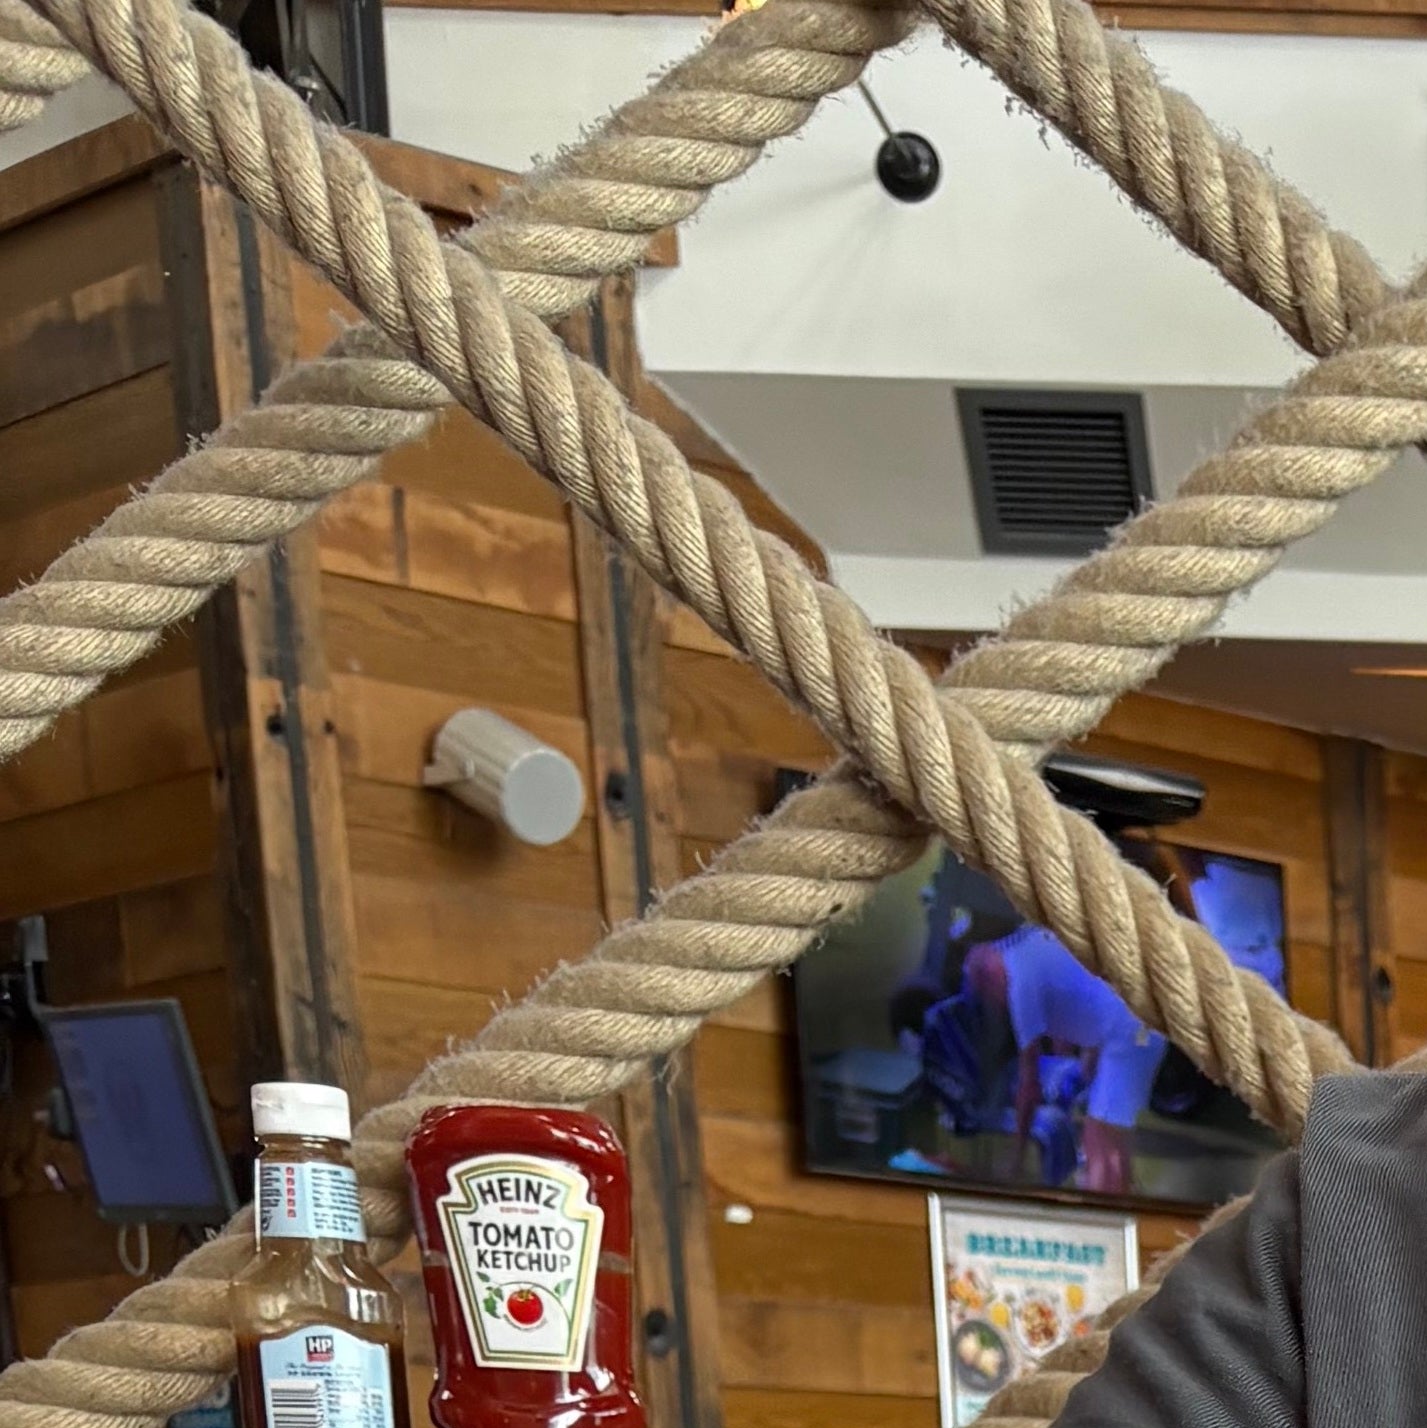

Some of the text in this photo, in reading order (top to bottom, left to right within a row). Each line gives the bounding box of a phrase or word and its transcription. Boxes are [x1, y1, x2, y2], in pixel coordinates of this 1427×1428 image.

[477, 1177, 561, 1210] HEINZ
[467, 1221, 574, 1252] TOMATO
[477, 1248, 571, 1273] KETCHUP
[308, 1337, 332, 1353] HP
